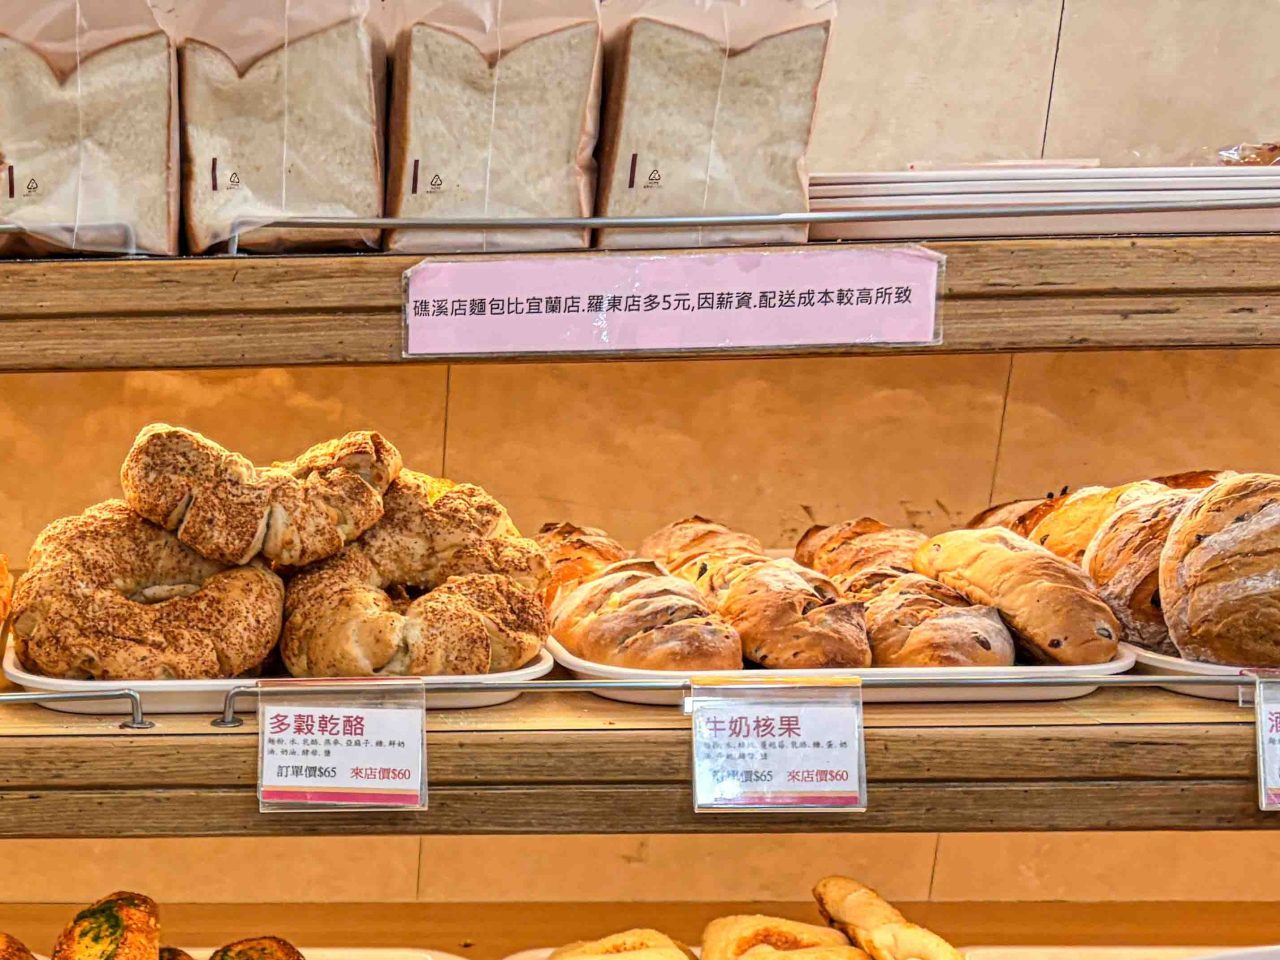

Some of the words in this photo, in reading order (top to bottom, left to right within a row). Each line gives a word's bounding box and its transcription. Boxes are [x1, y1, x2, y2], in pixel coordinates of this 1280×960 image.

[269, 713, 366, 736] 多穀乾酪
[706, 715, 802, 738] 牛奶核果
[276, 765, 337, 779] 訂單價$65
[350, 767, 411, 780] 來店價$60
[787, 769, 849, 782] 來店價$60
